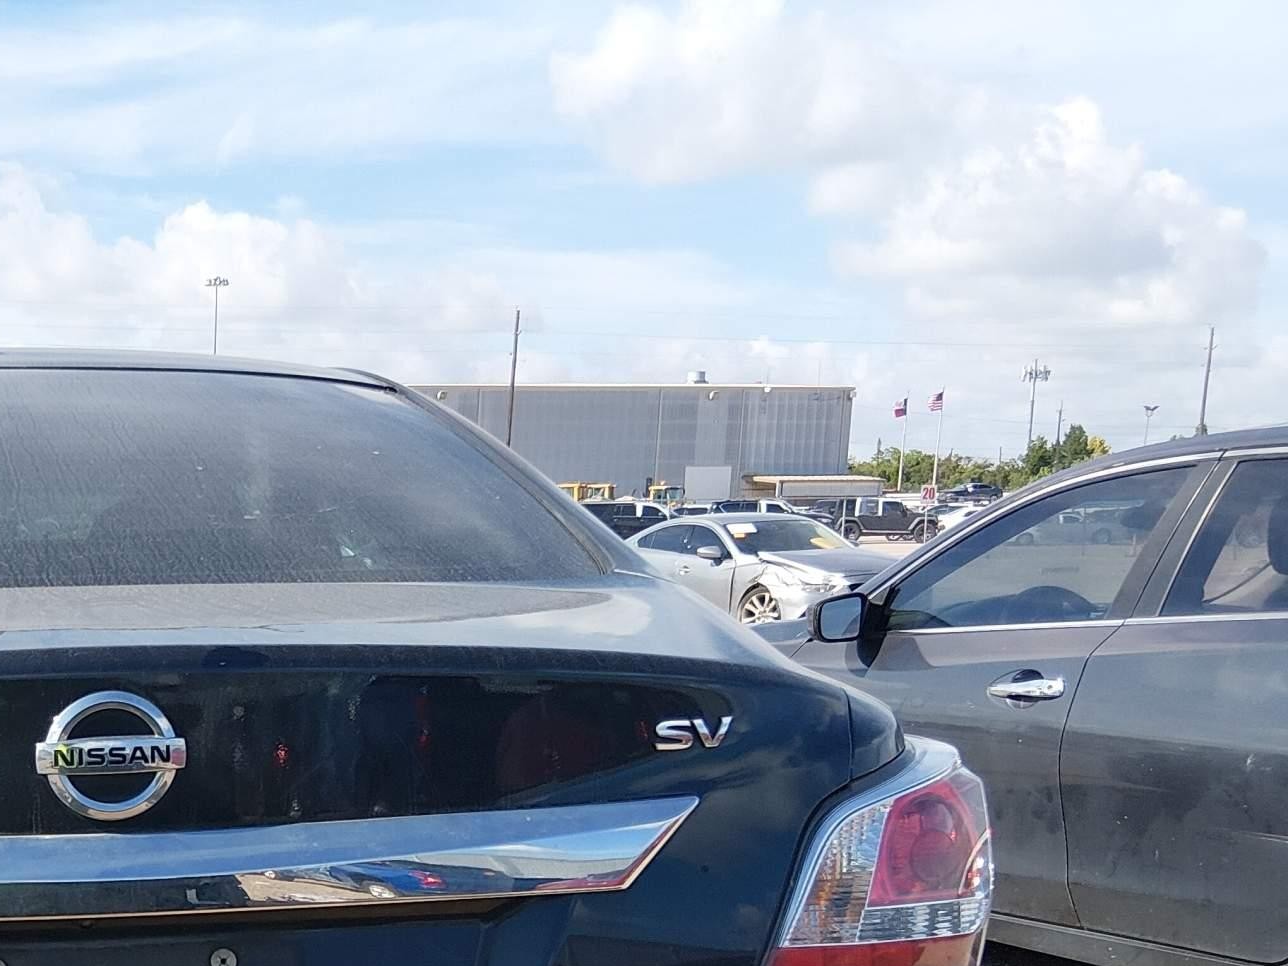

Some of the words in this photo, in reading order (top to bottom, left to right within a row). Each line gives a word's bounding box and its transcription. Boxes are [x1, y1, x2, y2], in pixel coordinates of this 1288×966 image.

[922, 487, 936, 500] 20
[655, 715, 733, 751] SV
[53, 744, 171, 767] NISSAN
